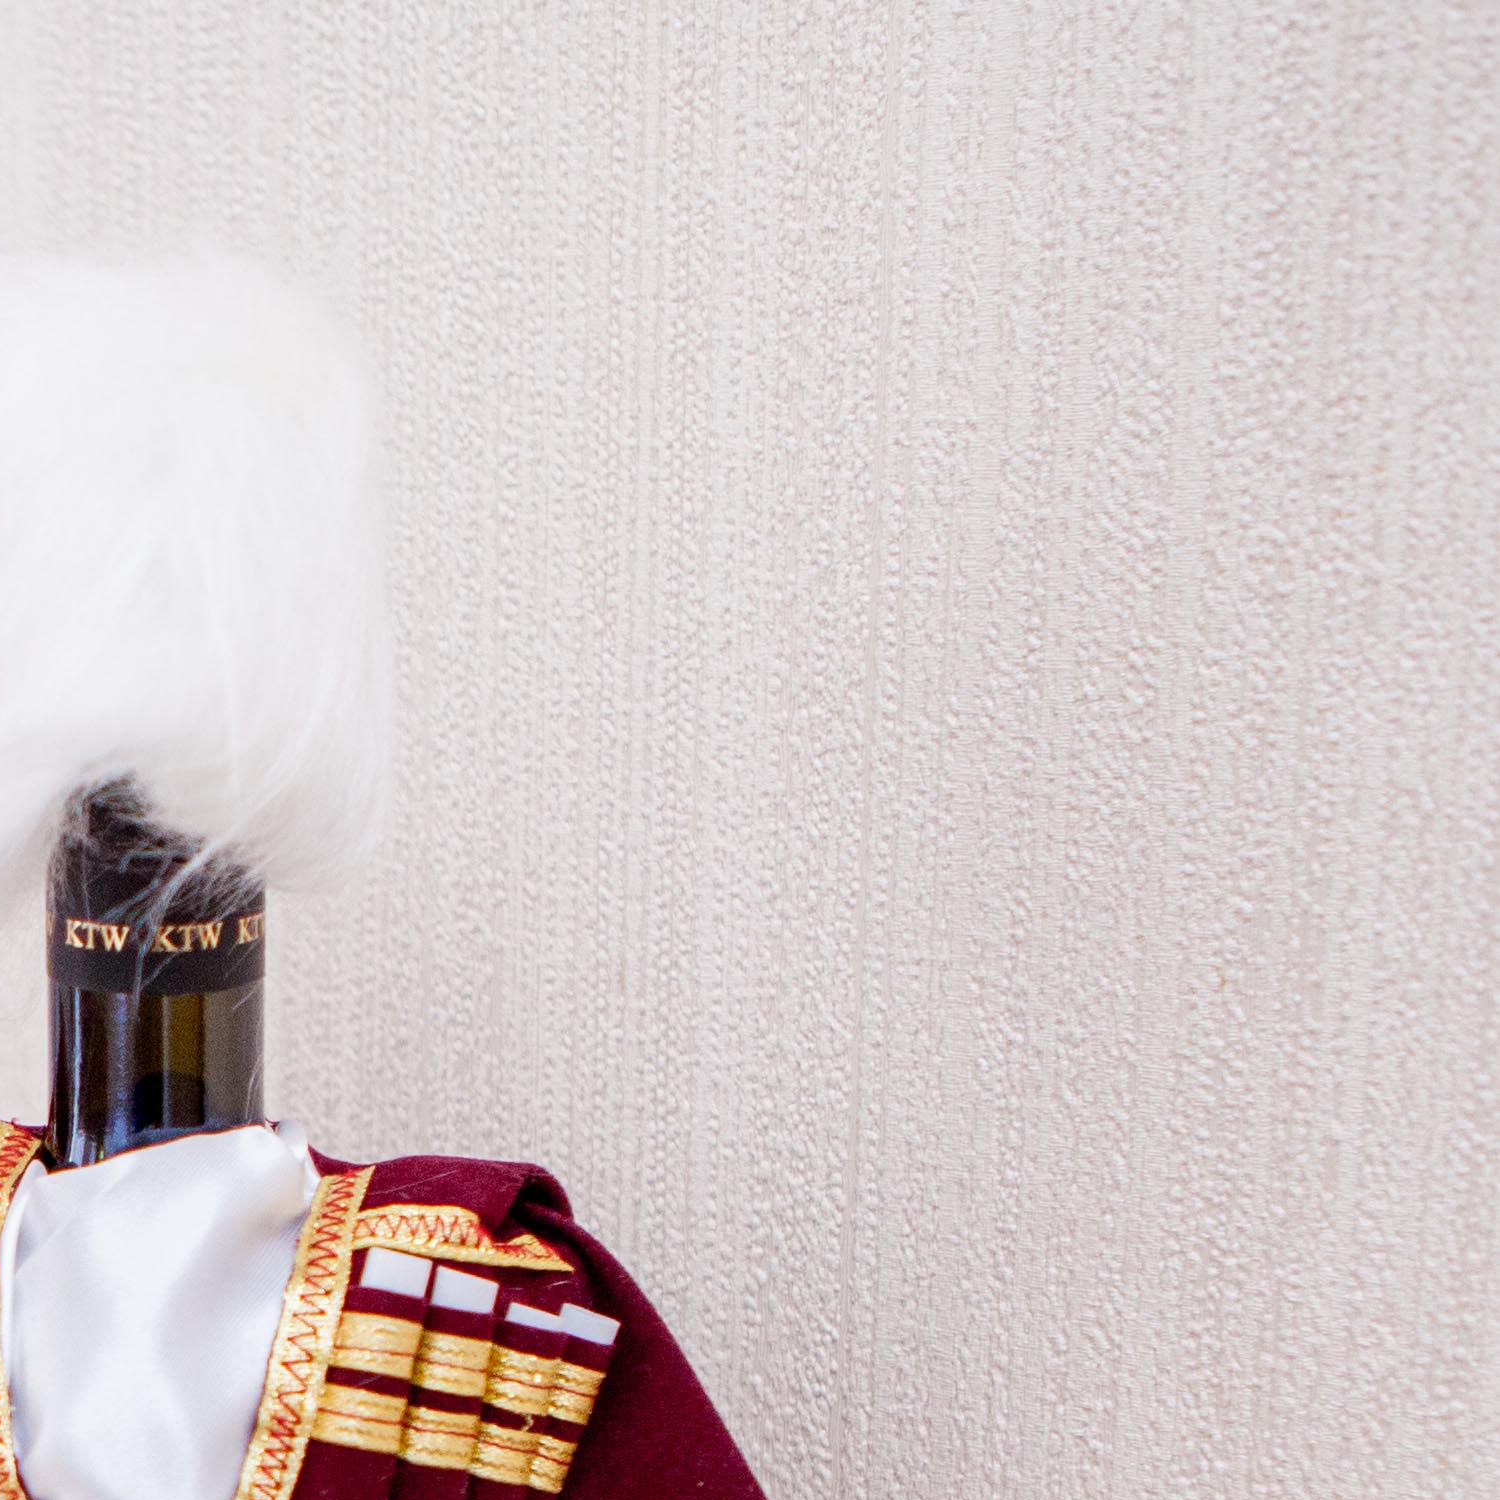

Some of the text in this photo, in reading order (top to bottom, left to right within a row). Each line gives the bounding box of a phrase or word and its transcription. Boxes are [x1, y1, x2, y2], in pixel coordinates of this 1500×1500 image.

[65, 918, 130, 952] KTW
[152, 920, 223, 952] KTW
[237, 912, 265, 945] KT
